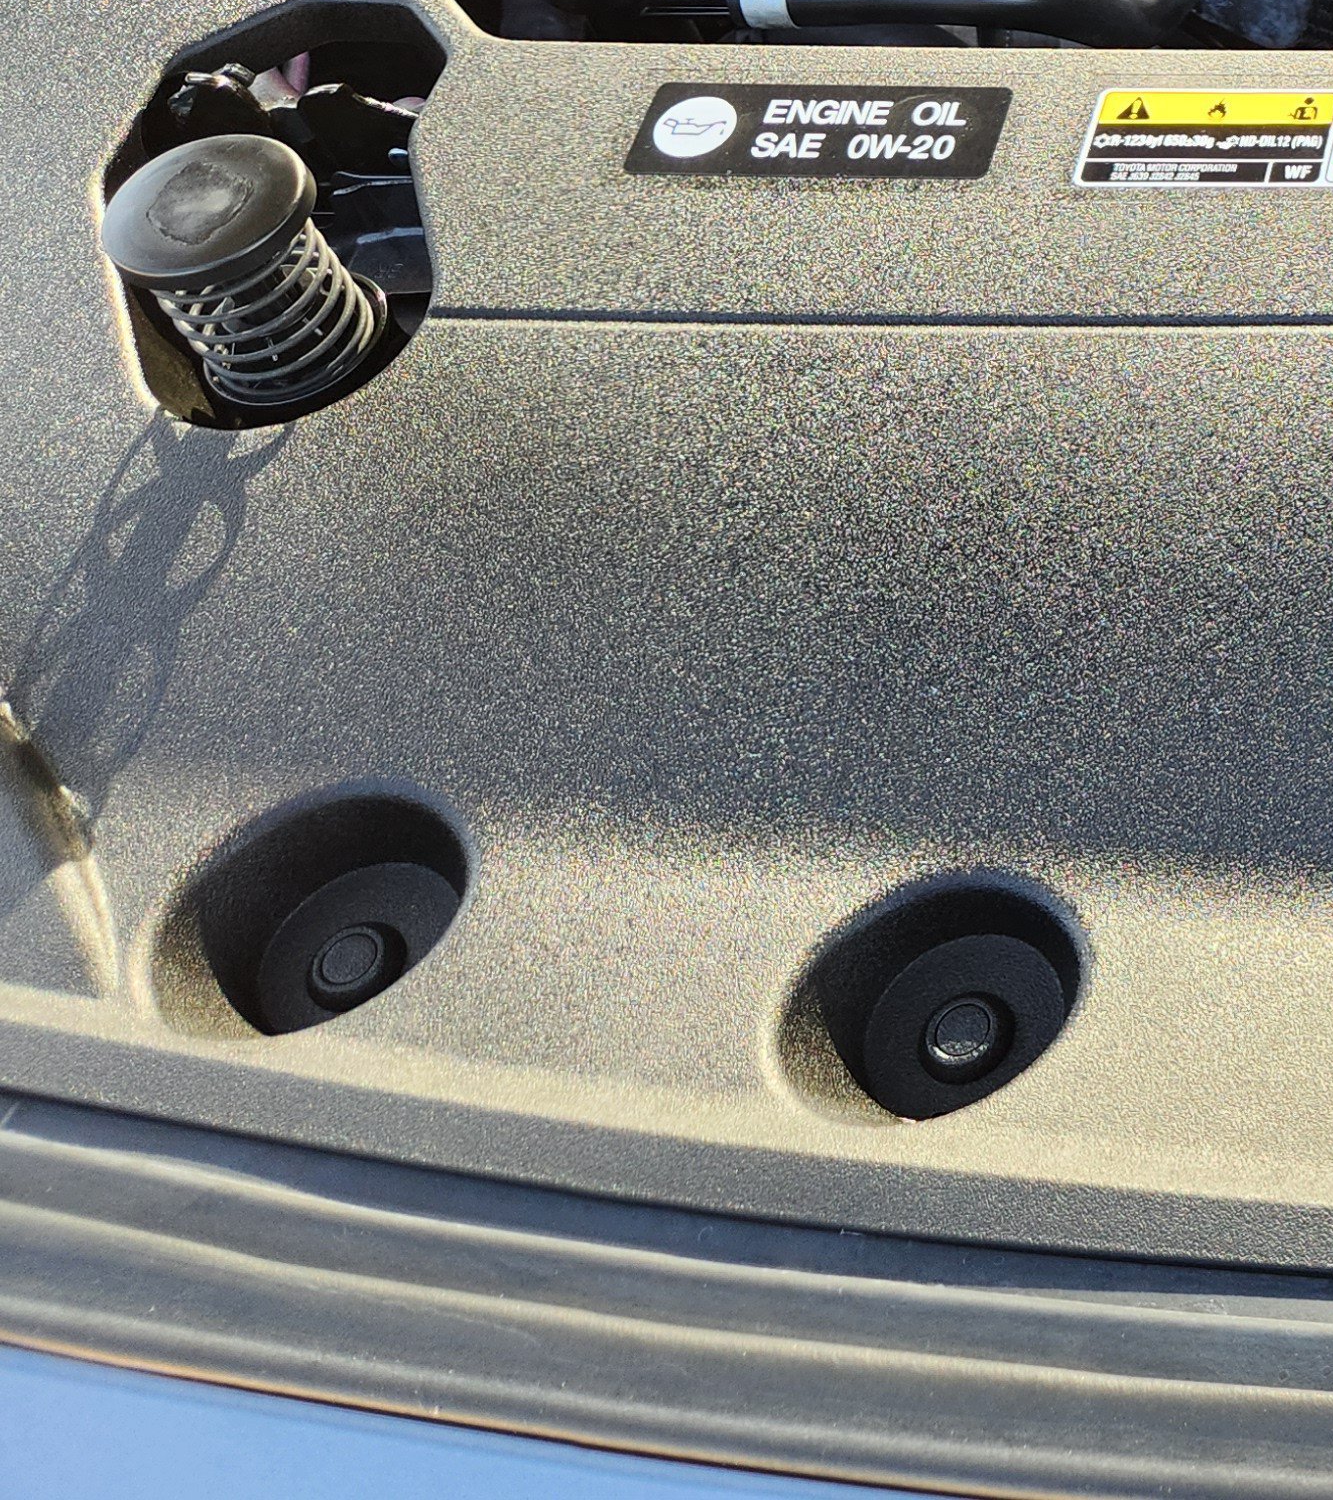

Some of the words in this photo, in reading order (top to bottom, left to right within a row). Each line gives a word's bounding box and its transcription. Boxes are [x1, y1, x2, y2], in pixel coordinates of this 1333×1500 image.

[762, 98, 894, 127] ENGINE
[911, 101, 968, 128] OIL
[751, 131, 826, 159] SAE
[847, 134, 956, 161] 0W-20
[1291, 134, 1324, 150] (PAG)
[1112, 163, 1146, 172] TOYOTA
[1147, 163, 1178, 172] MOTOR
[1178, 163, 1238, 173] CORPORATION
[1284, 164, 1313, 180] WF
[1109, 172, 1128, 181] SAE
